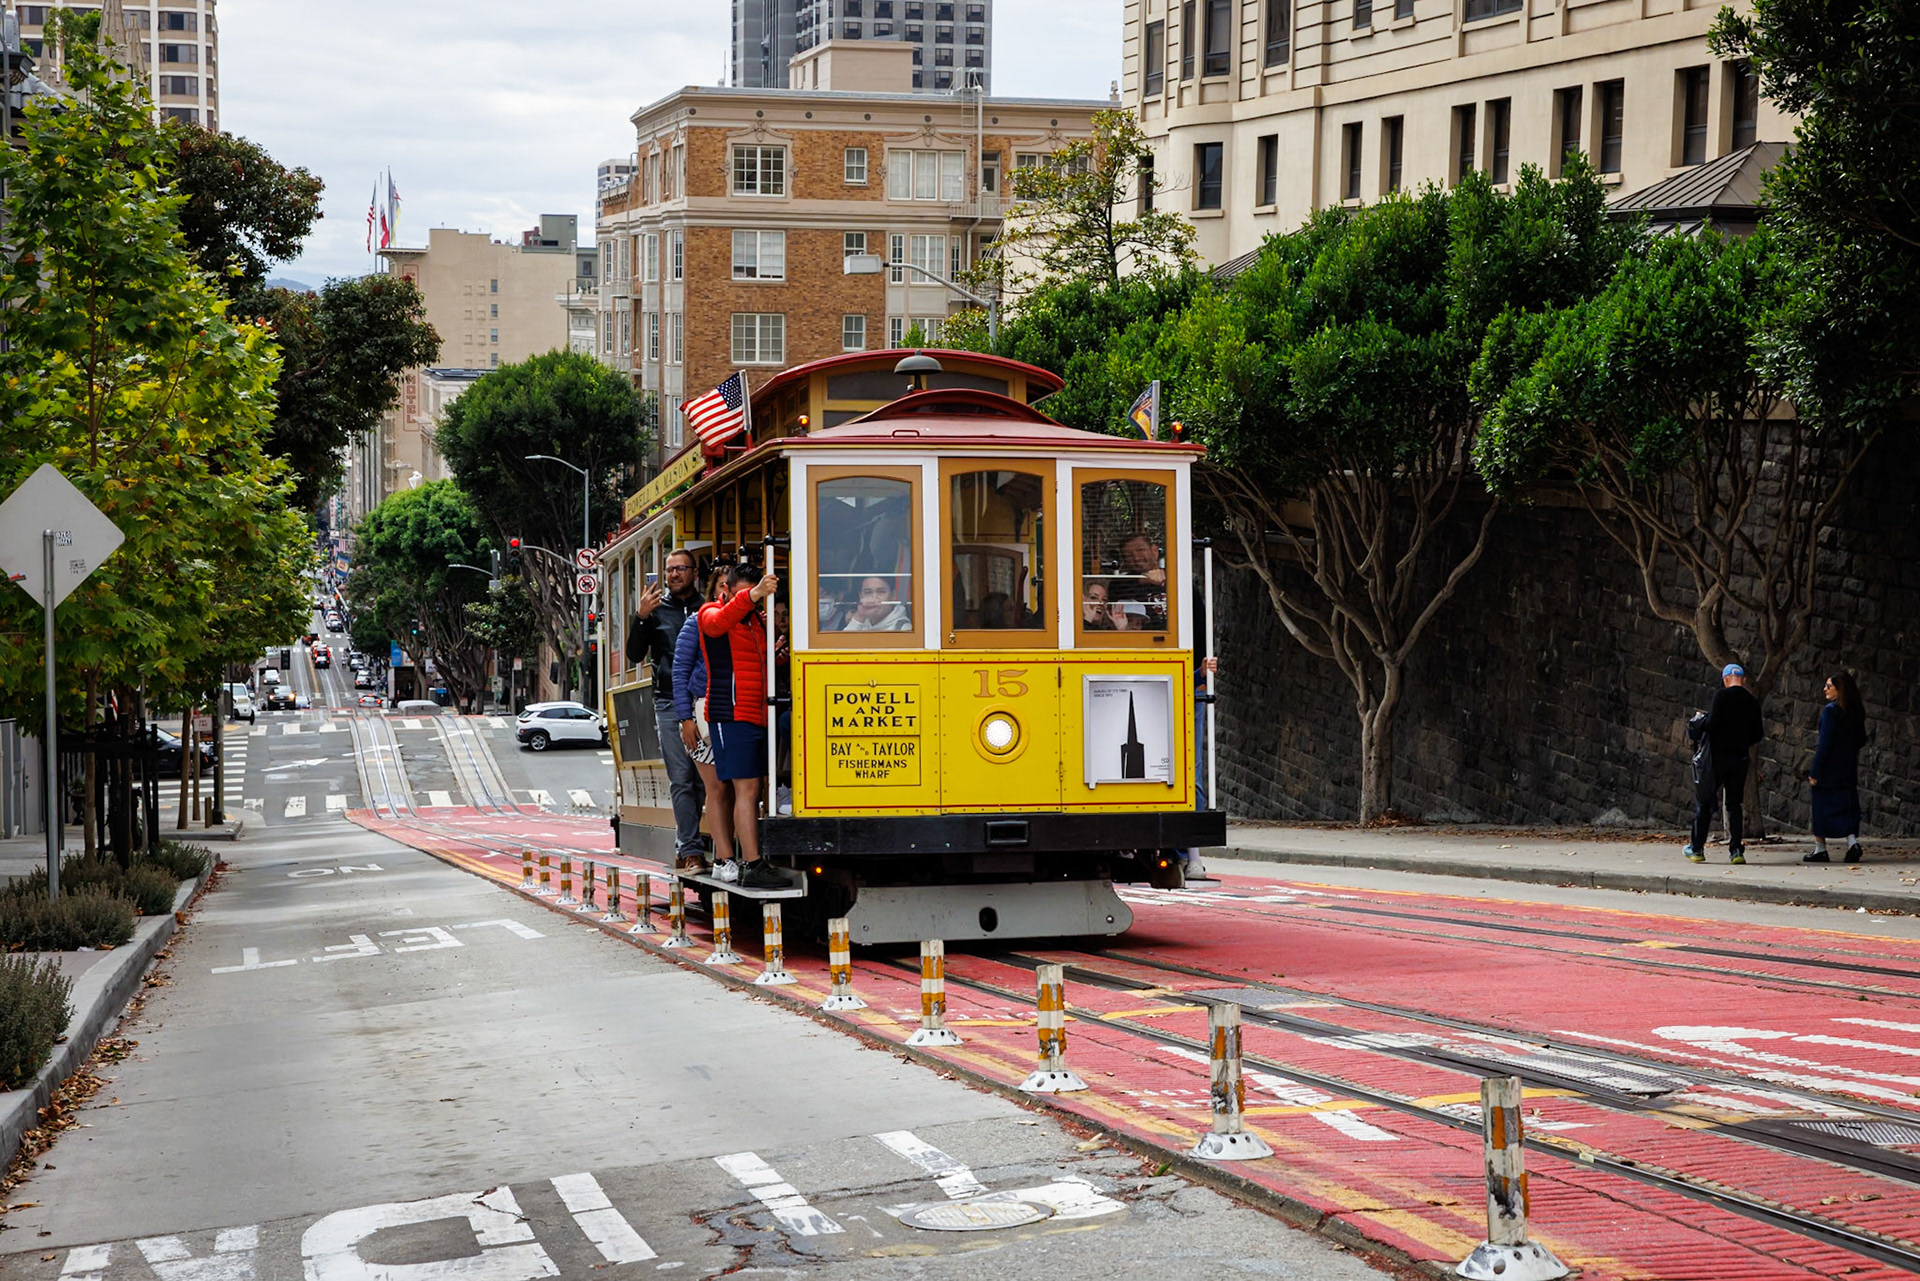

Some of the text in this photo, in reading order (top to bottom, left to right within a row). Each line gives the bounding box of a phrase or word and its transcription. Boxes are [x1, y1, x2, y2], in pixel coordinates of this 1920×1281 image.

[405, 374, 416, 423] HOTEL
[628, 489, 651, 516] POWELL
[664, 459, 689, 489] MASON
[973, 668, 1029, 698] 15
[833, 692, 915, 705] POWELL
[855, 705, 895, 715] AND
[832, 716, 917, 728] MARKET
[831, 742, 915, 756] BAY AND TAYLOR
[838, 759, 907, 769] FISHERMANS
[855, 769, 890, 779] WHARF
[287, 862, 384, 879] NO
[211, 918, 547, 974] LEFT
